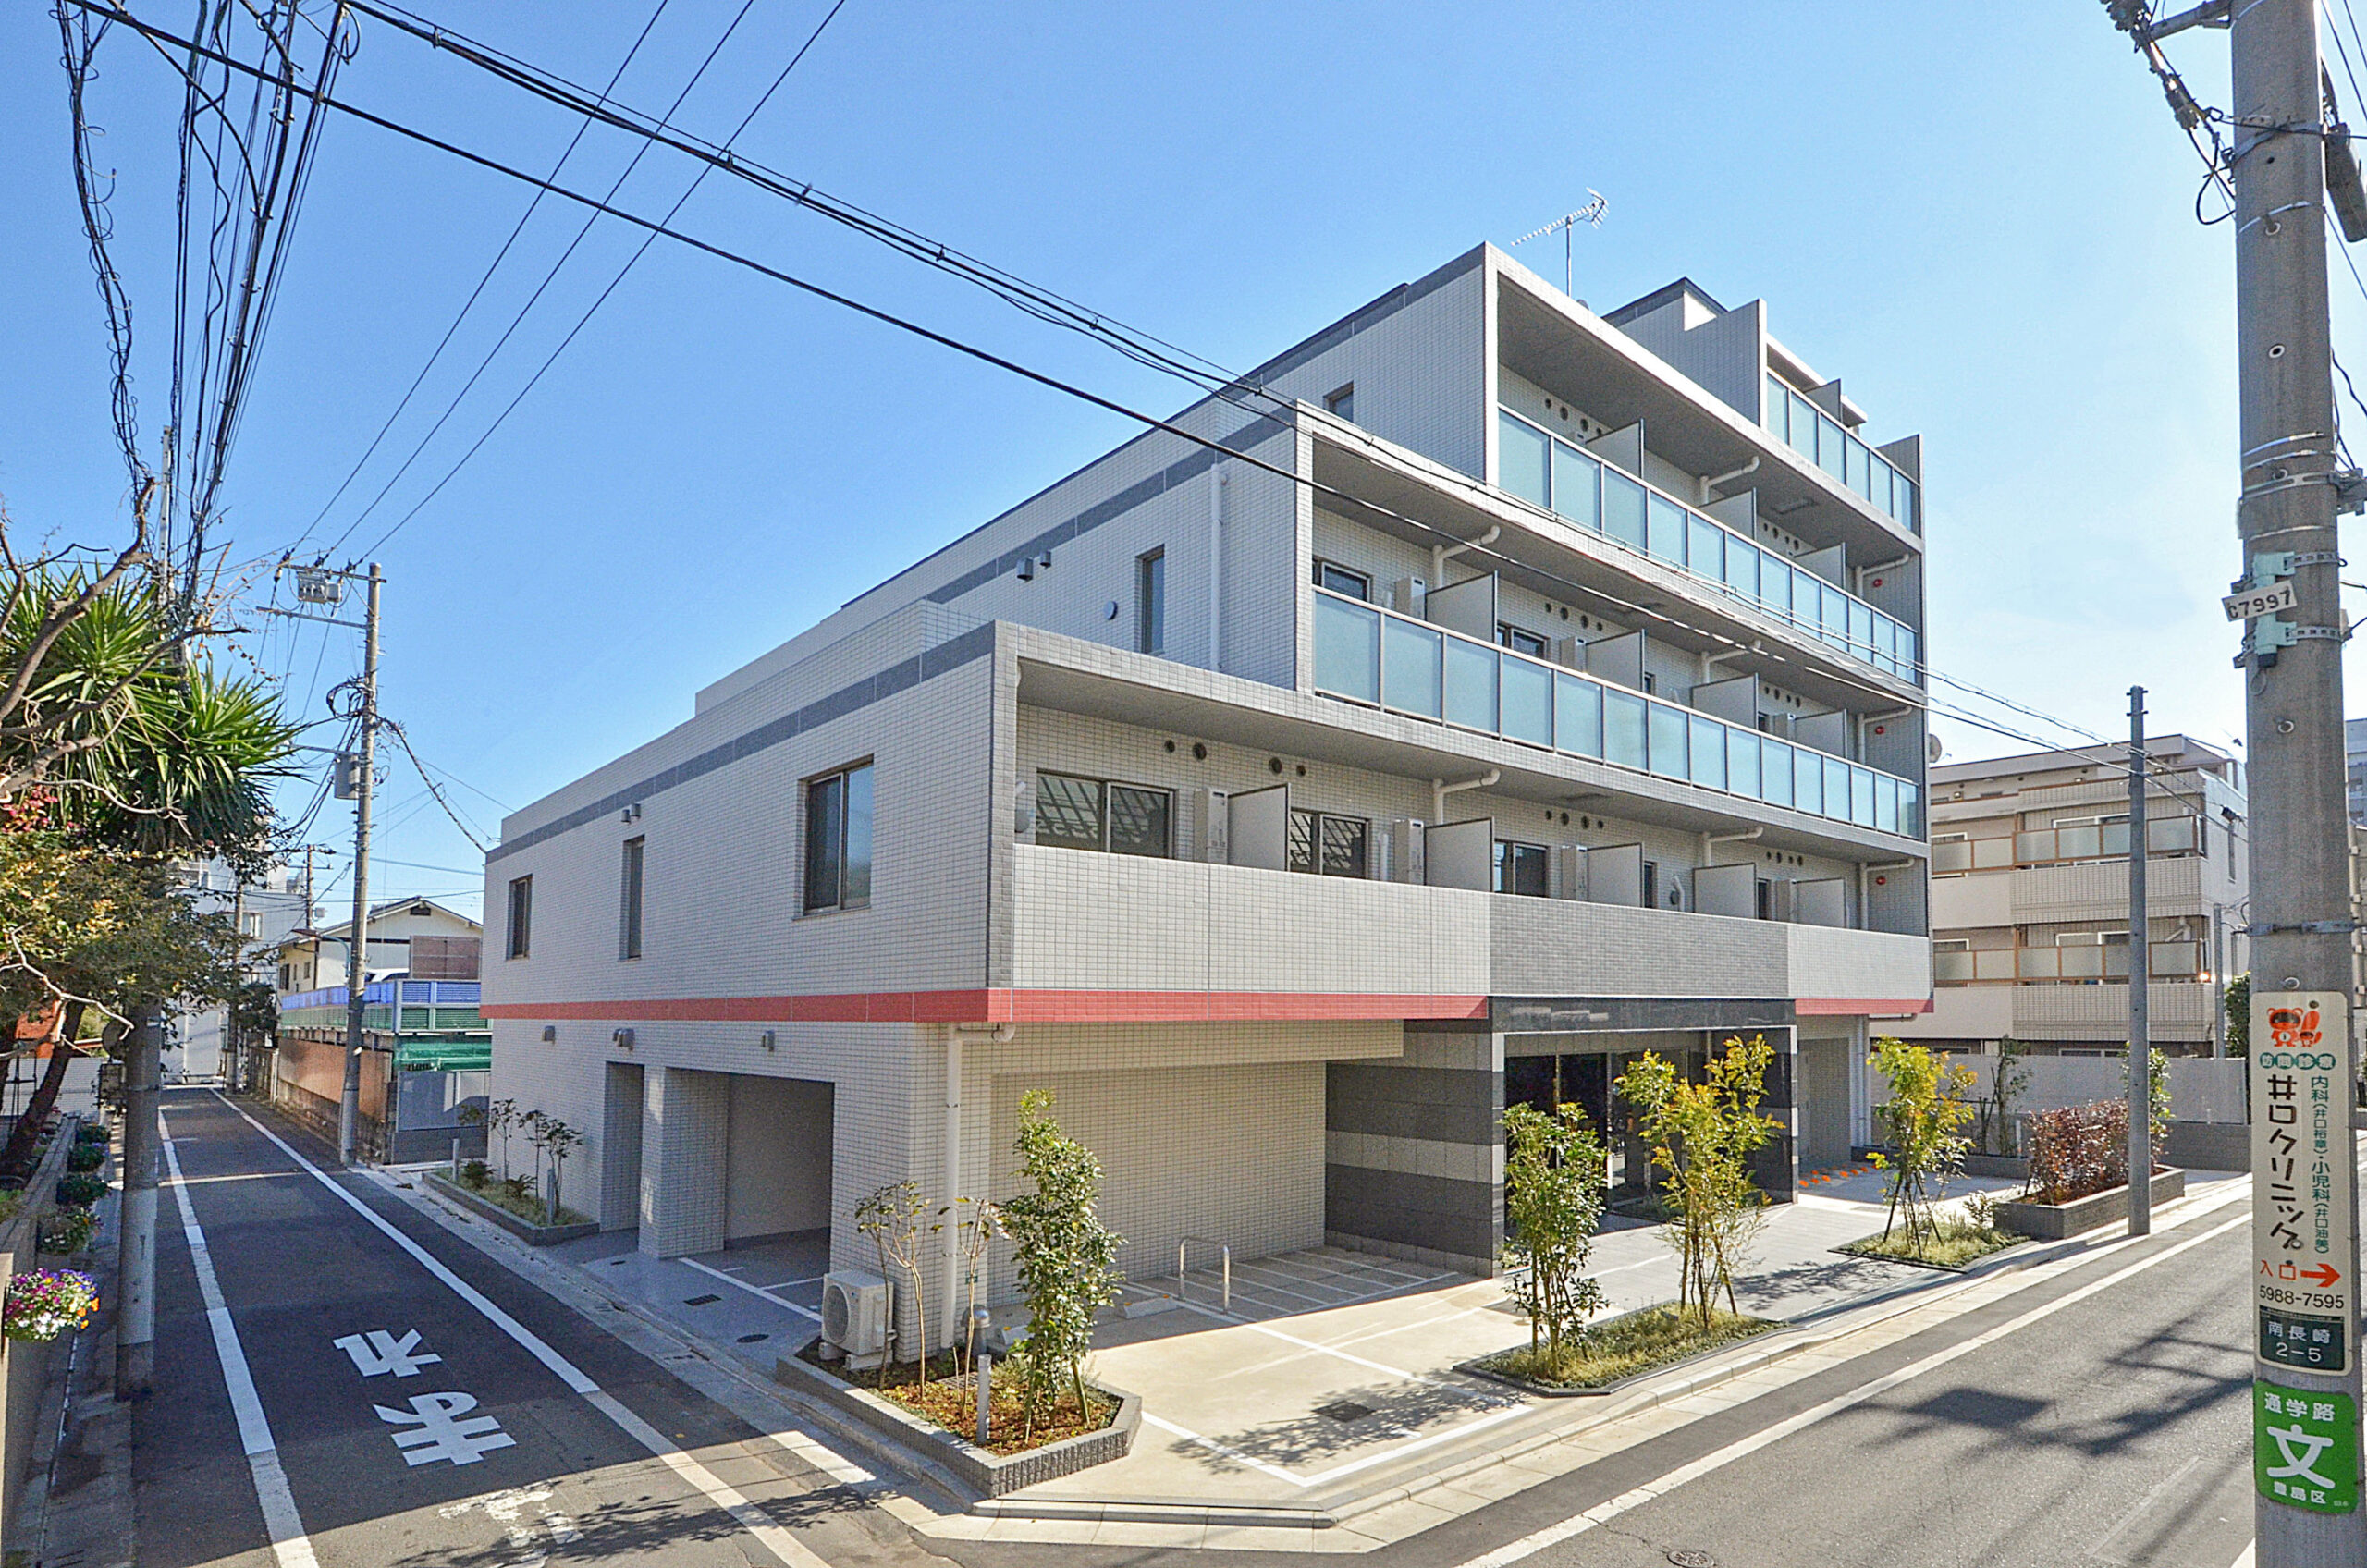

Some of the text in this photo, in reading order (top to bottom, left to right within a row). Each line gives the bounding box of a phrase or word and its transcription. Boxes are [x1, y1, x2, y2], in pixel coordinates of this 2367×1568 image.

[2267, 1073, 2304, 1249] 井口クリニック
[2259, 1259, 2297, 1280] 入口
[2259, 1285, 2345, 1309] 5988-7595
[2268, 1321, 2331, 1344] 南長崎
[2264, 1392, 2336, 1422] 通学路
[2266, 1424, 2336, 1489] 文
